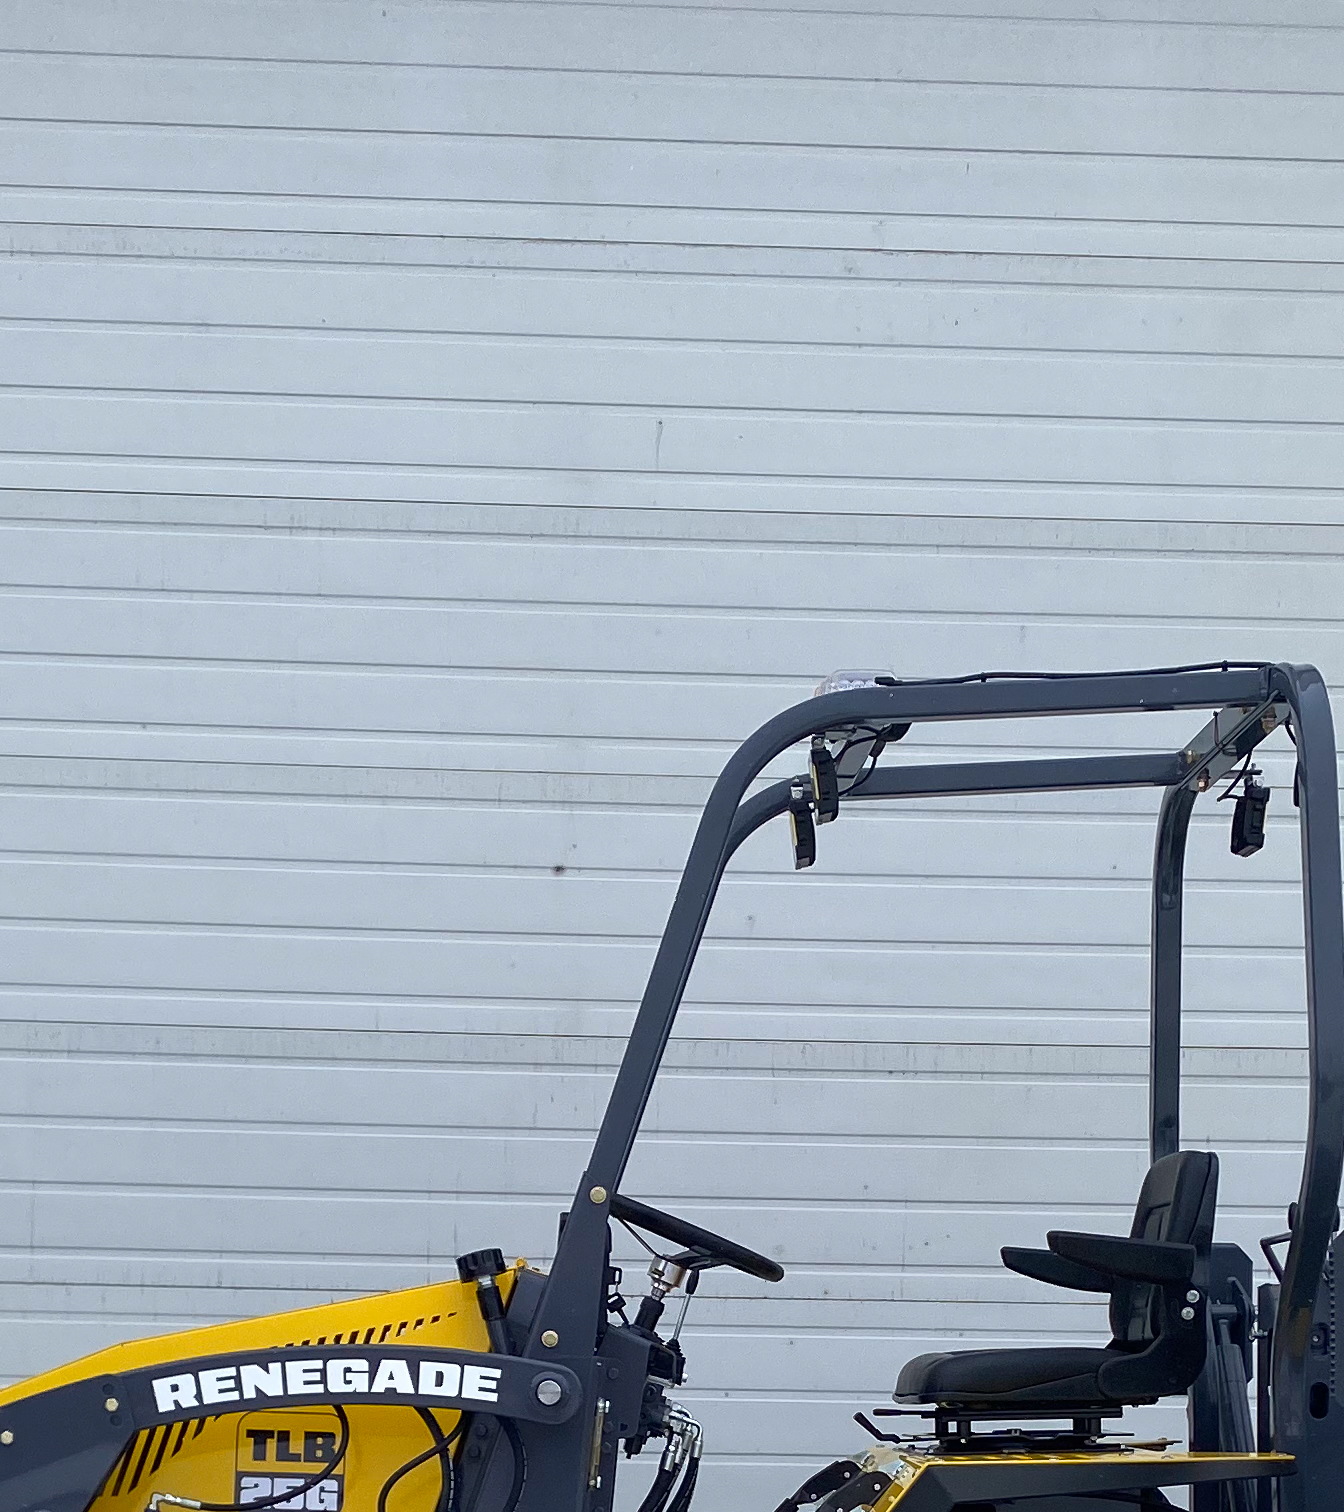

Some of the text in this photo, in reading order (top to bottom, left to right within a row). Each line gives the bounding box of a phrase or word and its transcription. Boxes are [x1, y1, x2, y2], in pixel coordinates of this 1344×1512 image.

[152, 1359, 502, 1413] RENEGADE
[246, 1429, 336, 1462] TLB
[240, 1477, 338, 1511] 25G
